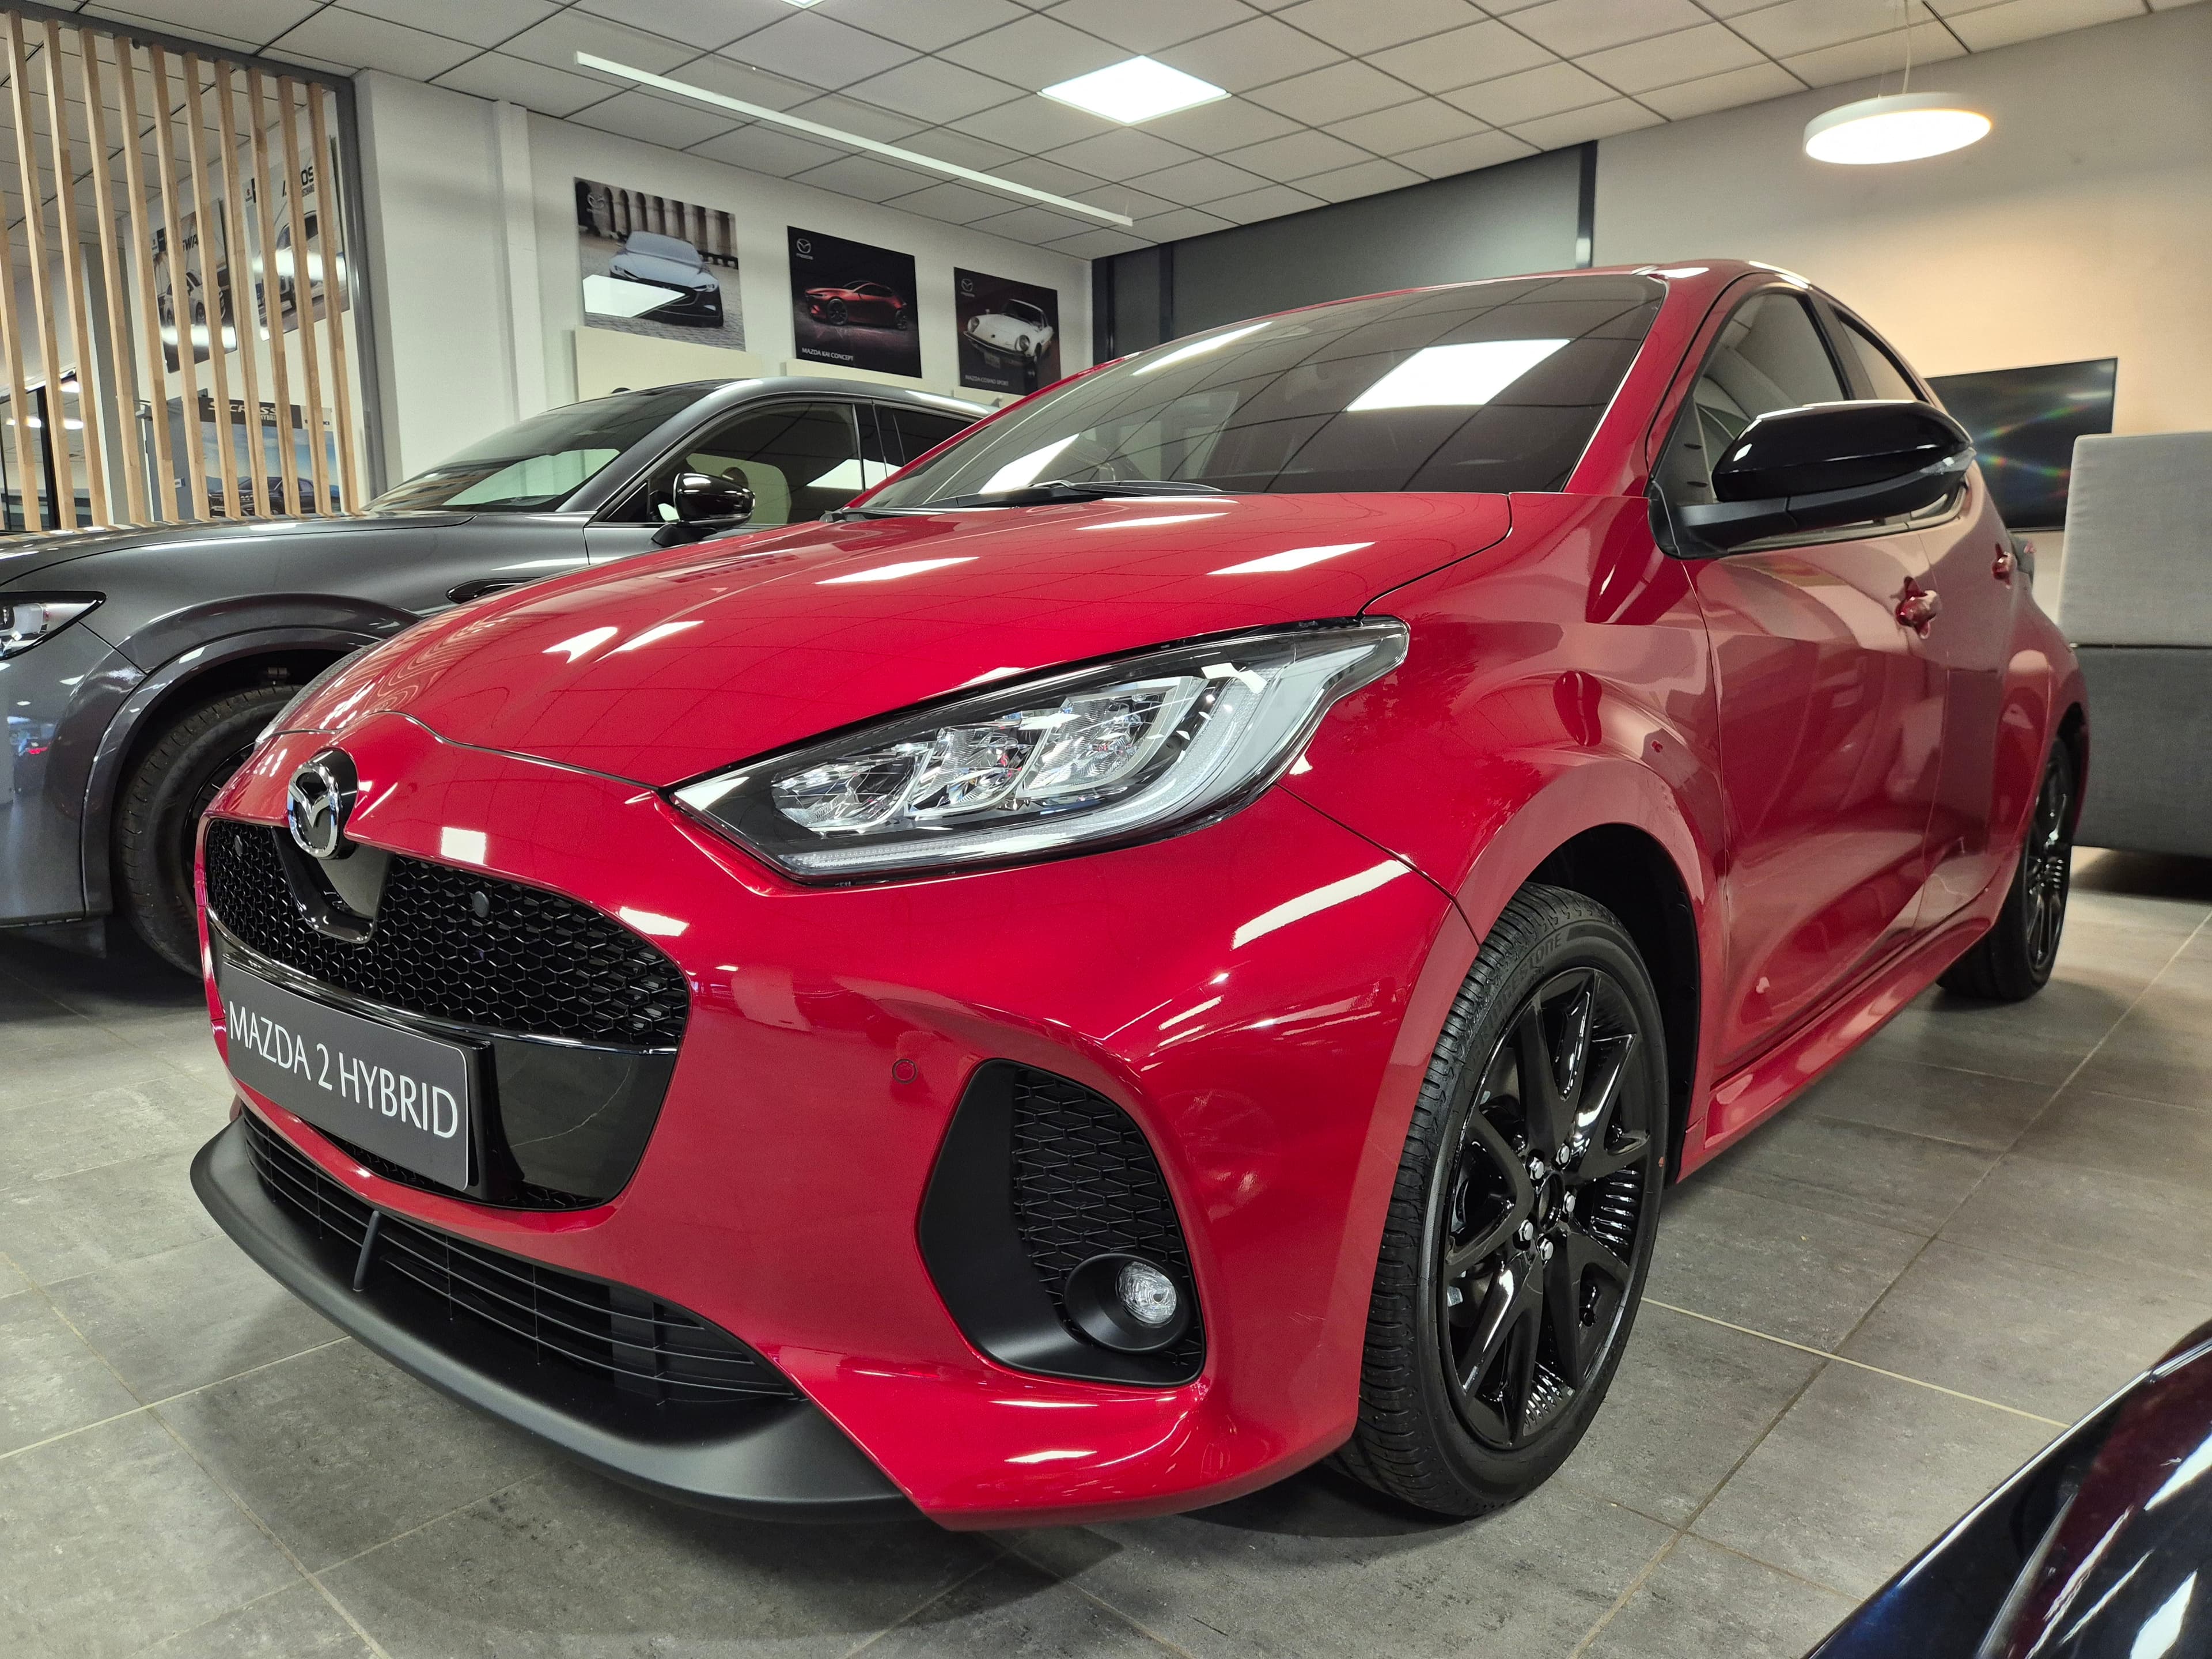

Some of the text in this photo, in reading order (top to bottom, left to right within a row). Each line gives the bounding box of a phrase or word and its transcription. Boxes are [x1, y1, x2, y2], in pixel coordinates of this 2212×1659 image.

[802, 347, 821, 356] MAZDA
[831, 353, 853, 361] CONCEPT
[229, 1001, 458, 1138] MAZDA 2 HYBRID
